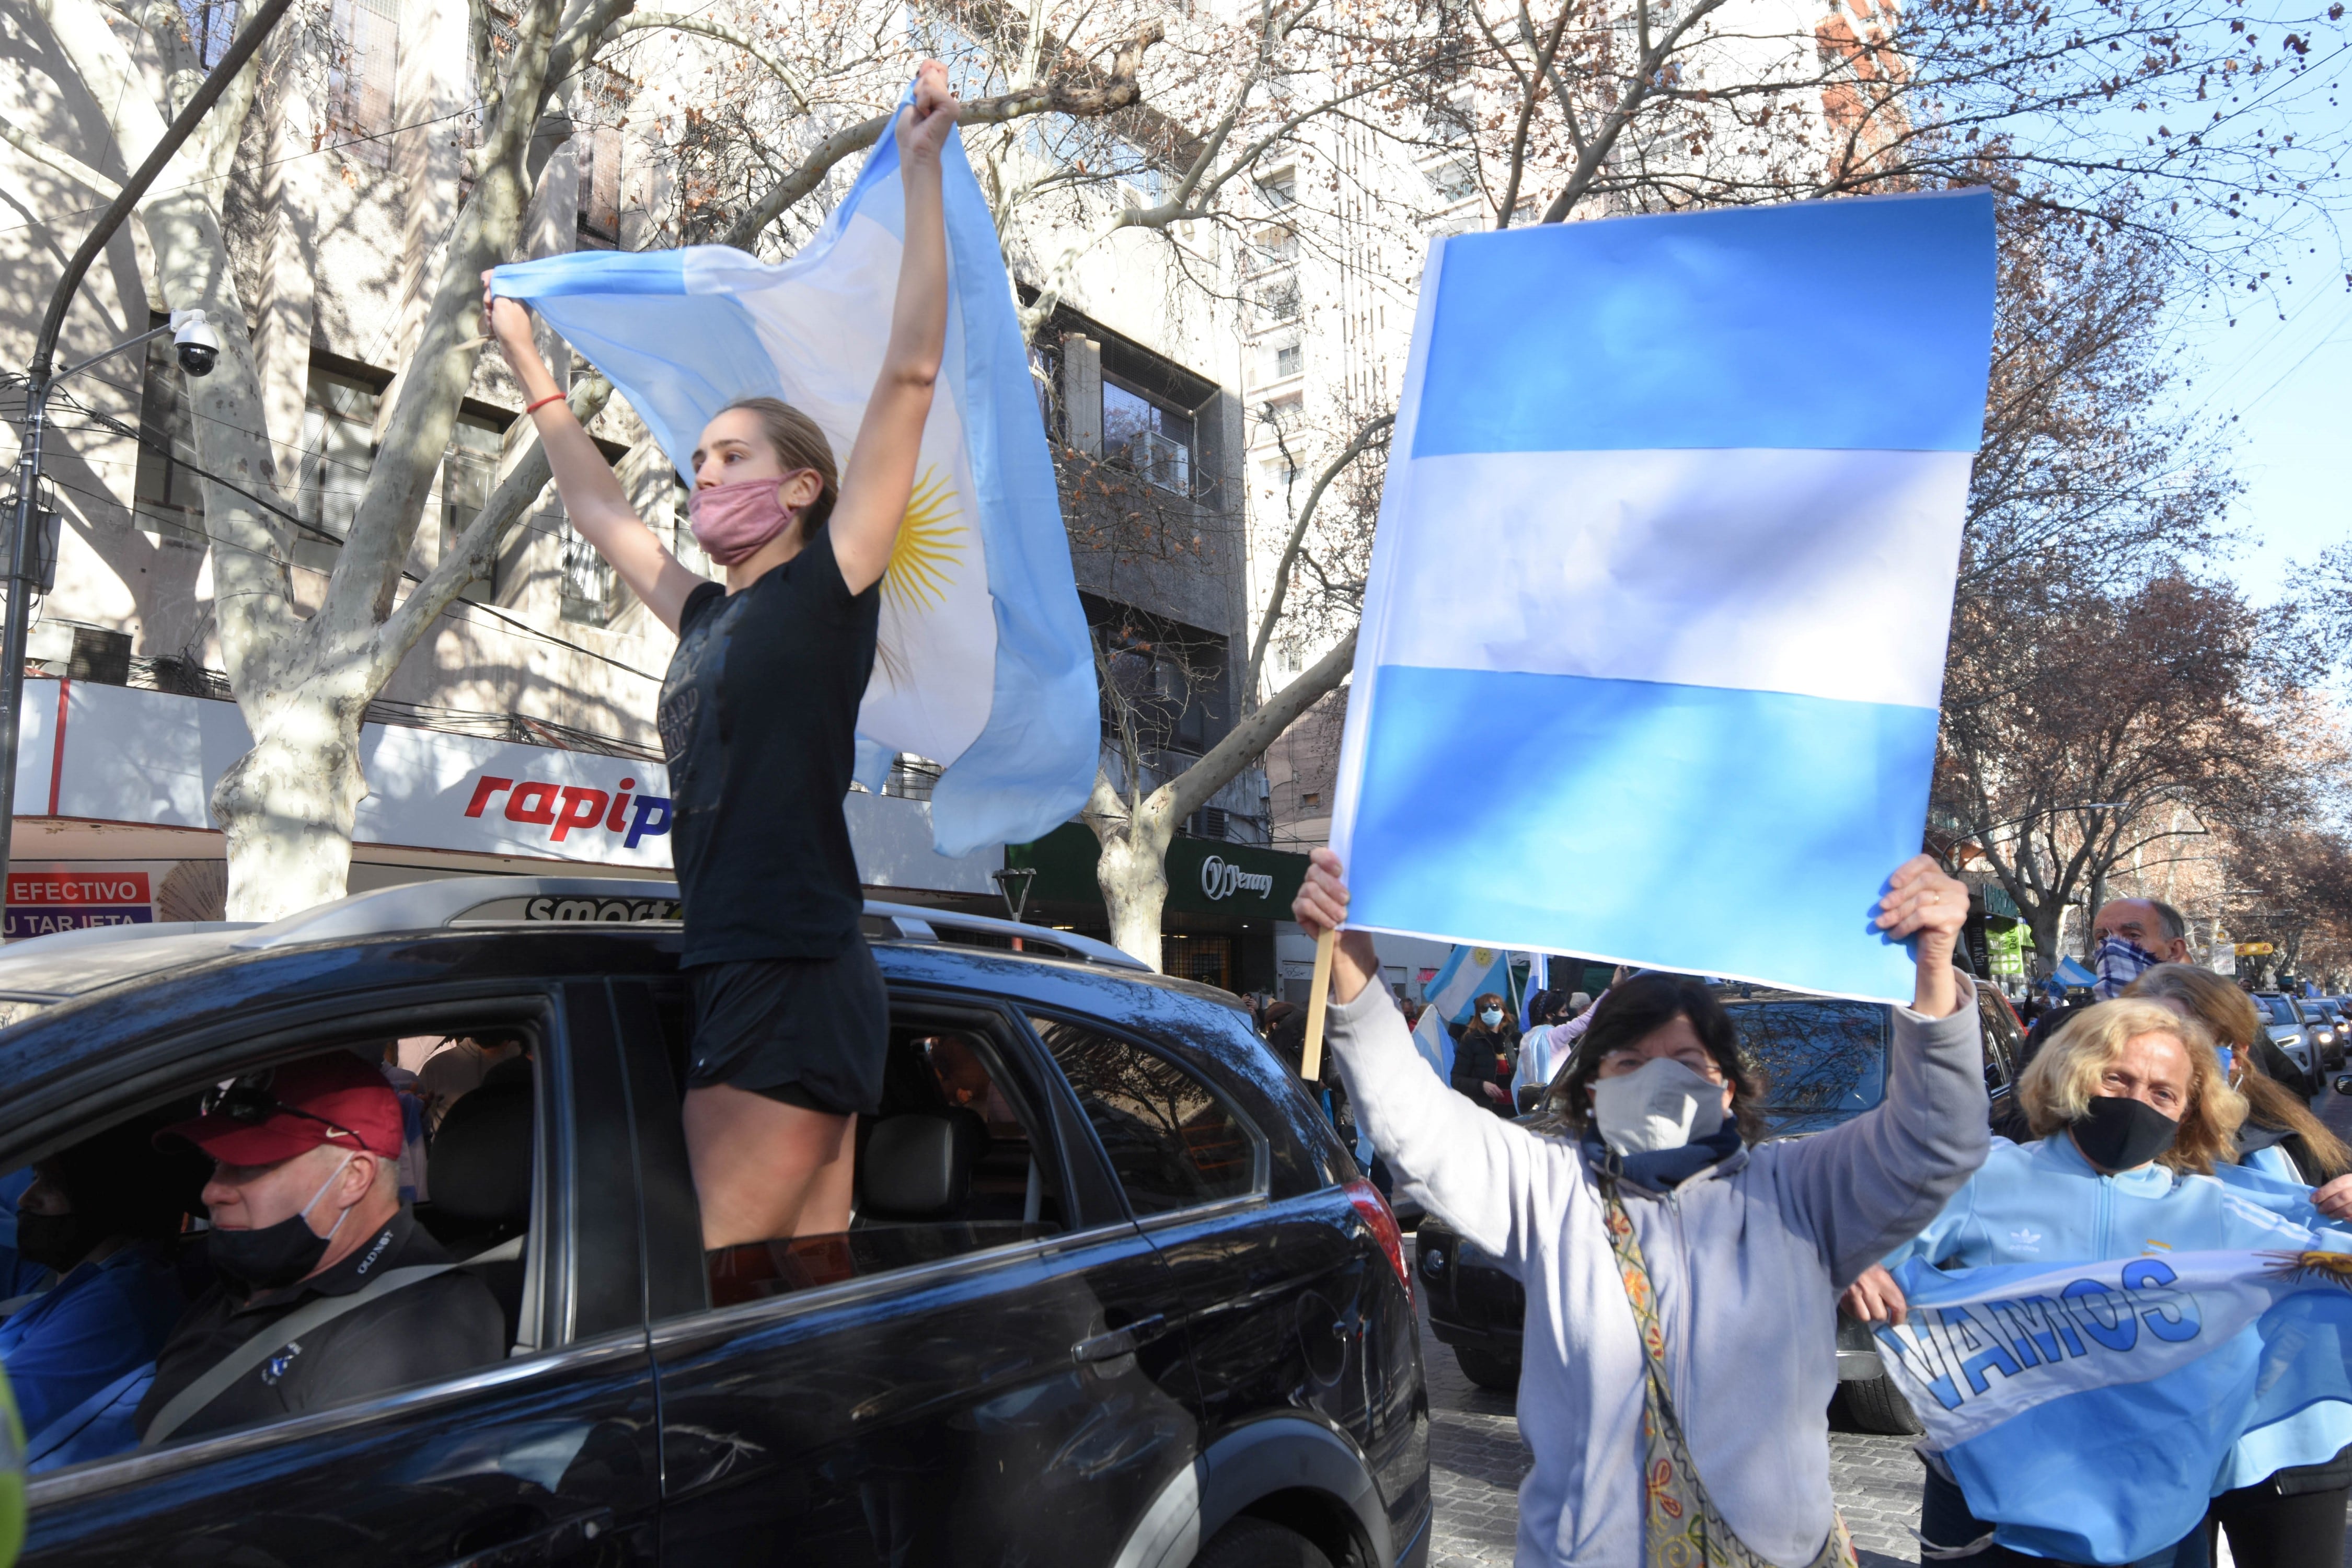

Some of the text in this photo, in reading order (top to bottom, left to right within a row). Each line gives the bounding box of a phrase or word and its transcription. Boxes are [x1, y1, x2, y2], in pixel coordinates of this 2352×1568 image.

[464, 776, 672, 849] rapip
[14, 882, 137, 901] EFECTIVO
[1225, 864, 1273, 899] Yenny
[2008, 936, 2017, 950] Del
[1874, 1259, 2202, 1411] VAMOS
